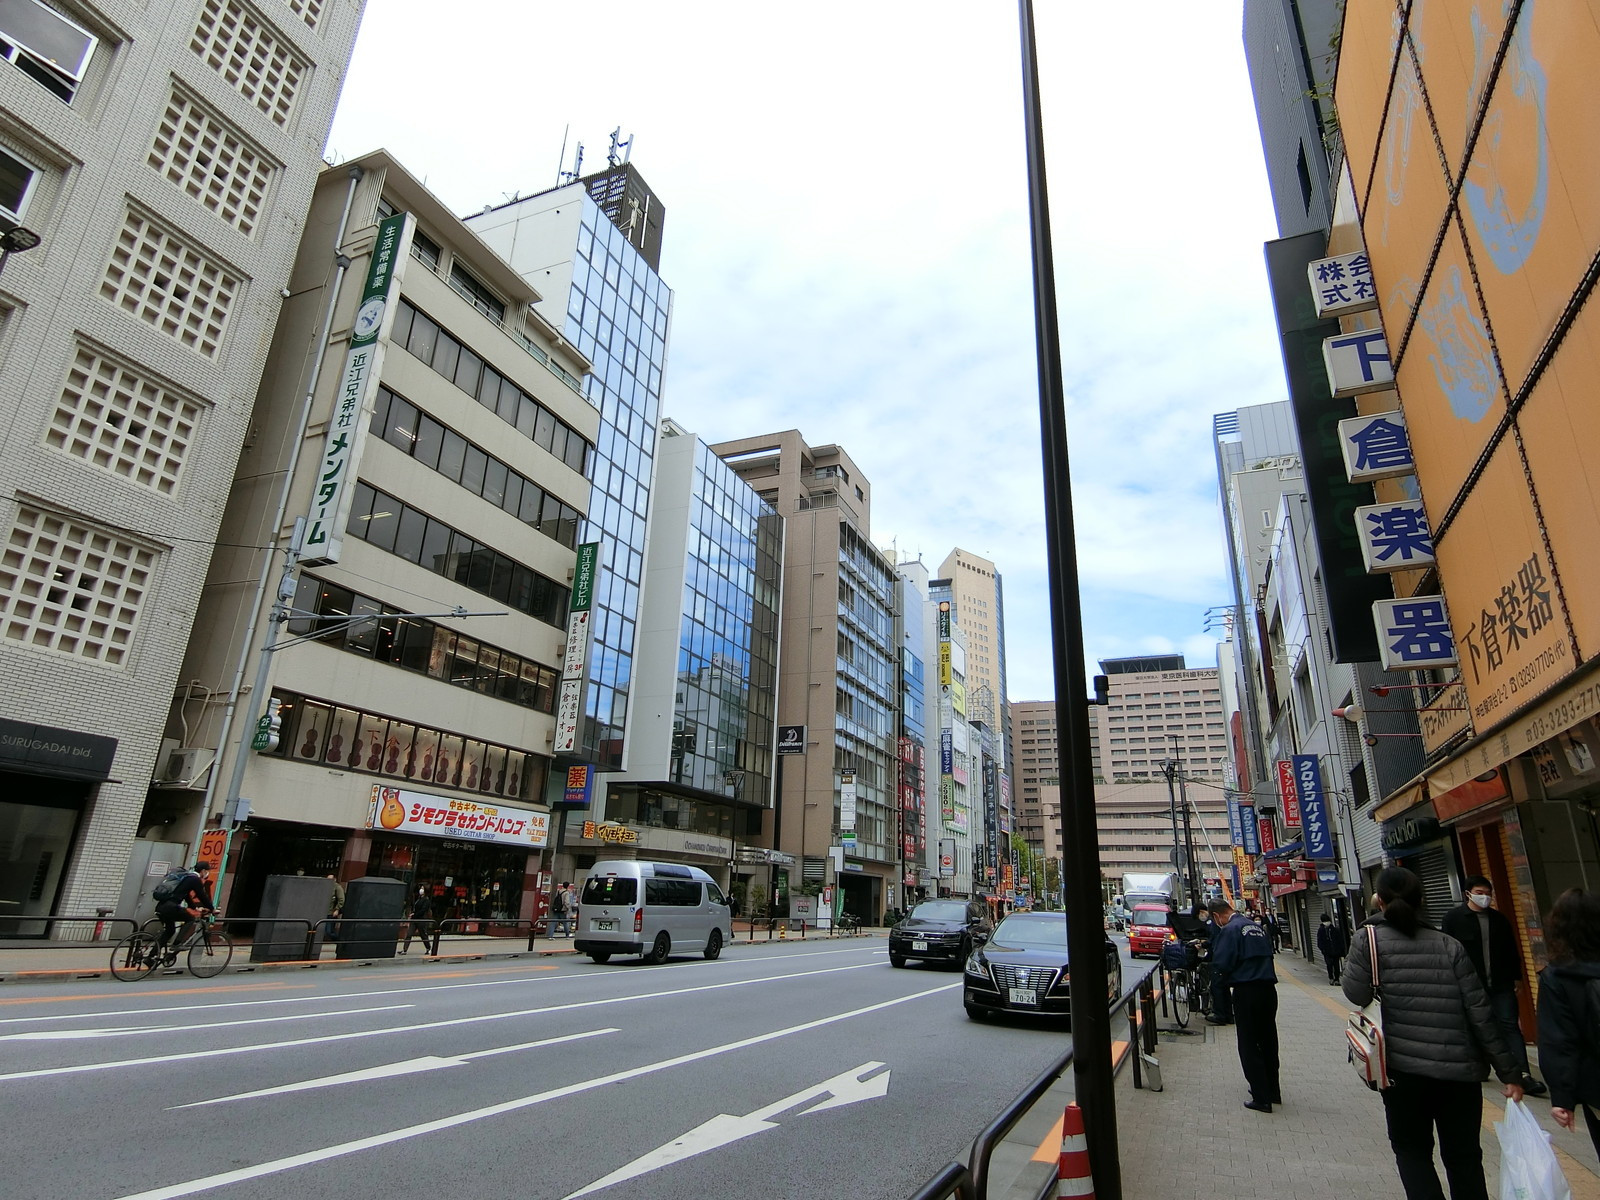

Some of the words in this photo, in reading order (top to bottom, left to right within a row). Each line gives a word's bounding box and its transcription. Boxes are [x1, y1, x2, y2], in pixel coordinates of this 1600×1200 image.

[372, 226, 396, 289] 生活常備薬
[337, 353, 368, 428] 近江兄弟社
[306, 432, 348, 545] メンターム
[576, 547, 593, 607] 近江兄弟社ビル
[1460, 552, 1554, 686] 下倉楽器
[1, 734, 70, 754] SURUGADAI
[72, 746, 93, 758] bld.
[569, 767, 586, 786] 薬
[409, 803, 527, 836] シモクラセカンドハンズ
[1300, 760, 1324, 853] クロサワバイオリン
[202, 840, 223, 856] 50
[444, 827, 462, 836] USED
[463, 831, 482, 839] GUITAR
[1015, 995, 1035, 1003] 70-24
